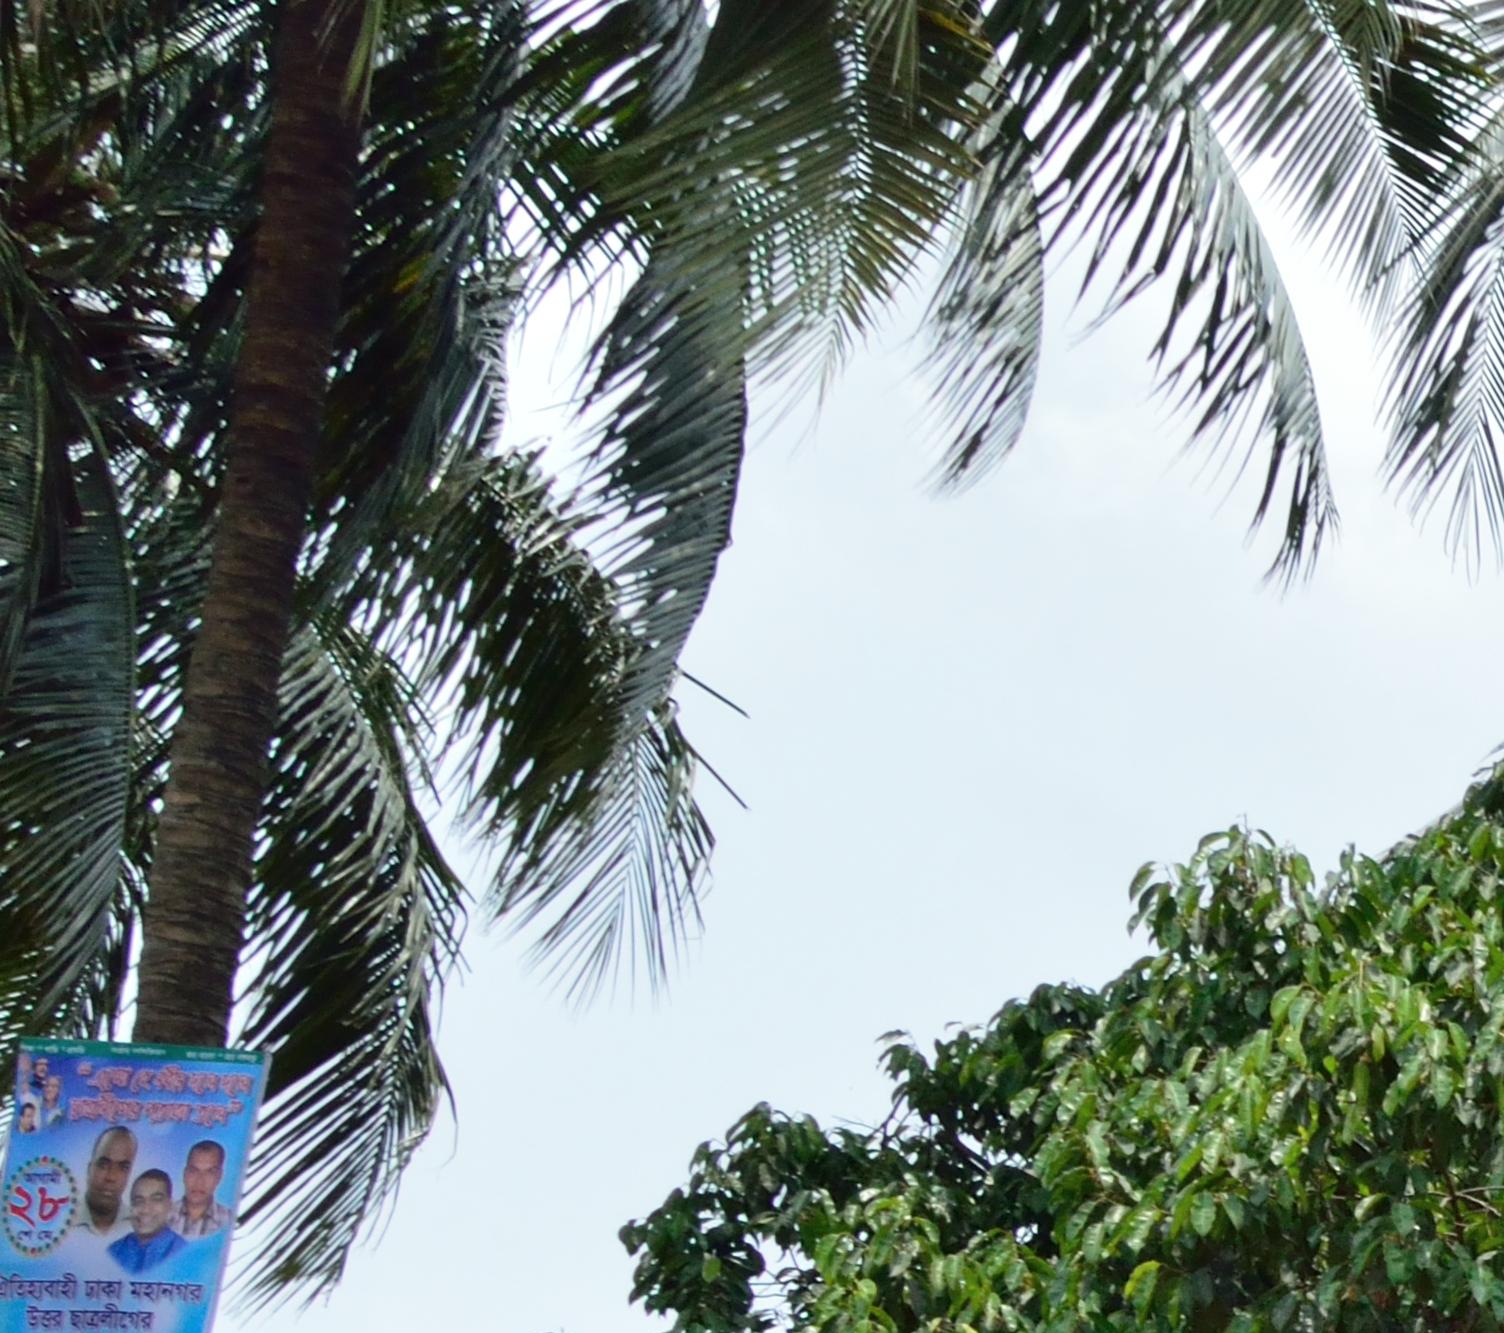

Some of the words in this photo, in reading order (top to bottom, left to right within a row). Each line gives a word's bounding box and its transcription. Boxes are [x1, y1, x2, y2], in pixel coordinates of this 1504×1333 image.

[9, 1186, 70, 1229] ২৮
[84, 1279, 123, 1299] ঢাকা
[130, 1281, 204, 1303] মহানগর
[26, 1306, 62, 1329] উত্তর
[70, 1303, 155, 1330] ছাত্রলীগের
